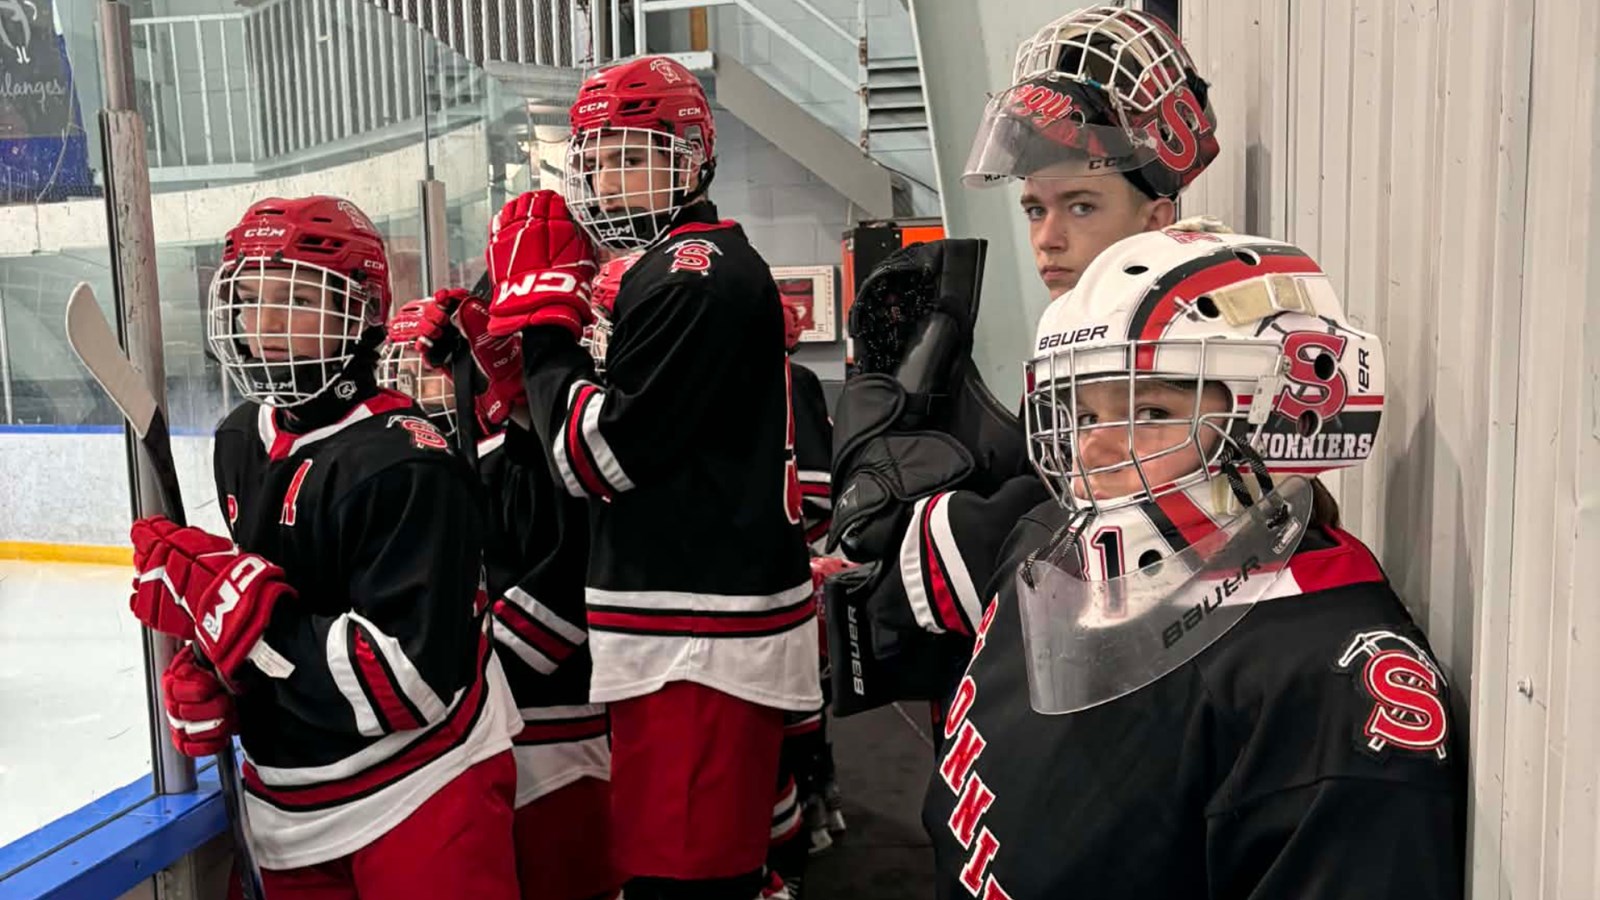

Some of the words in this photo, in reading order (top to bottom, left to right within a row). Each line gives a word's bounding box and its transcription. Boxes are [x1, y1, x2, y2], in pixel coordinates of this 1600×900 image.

[578, 101, 609, 114] CCM
[1144, 85, 1212, 172] S
[244, 227, 286, 238] CCM
[1275, 330, 1350, 423] S
[1363, 649, 1447, 751] S
